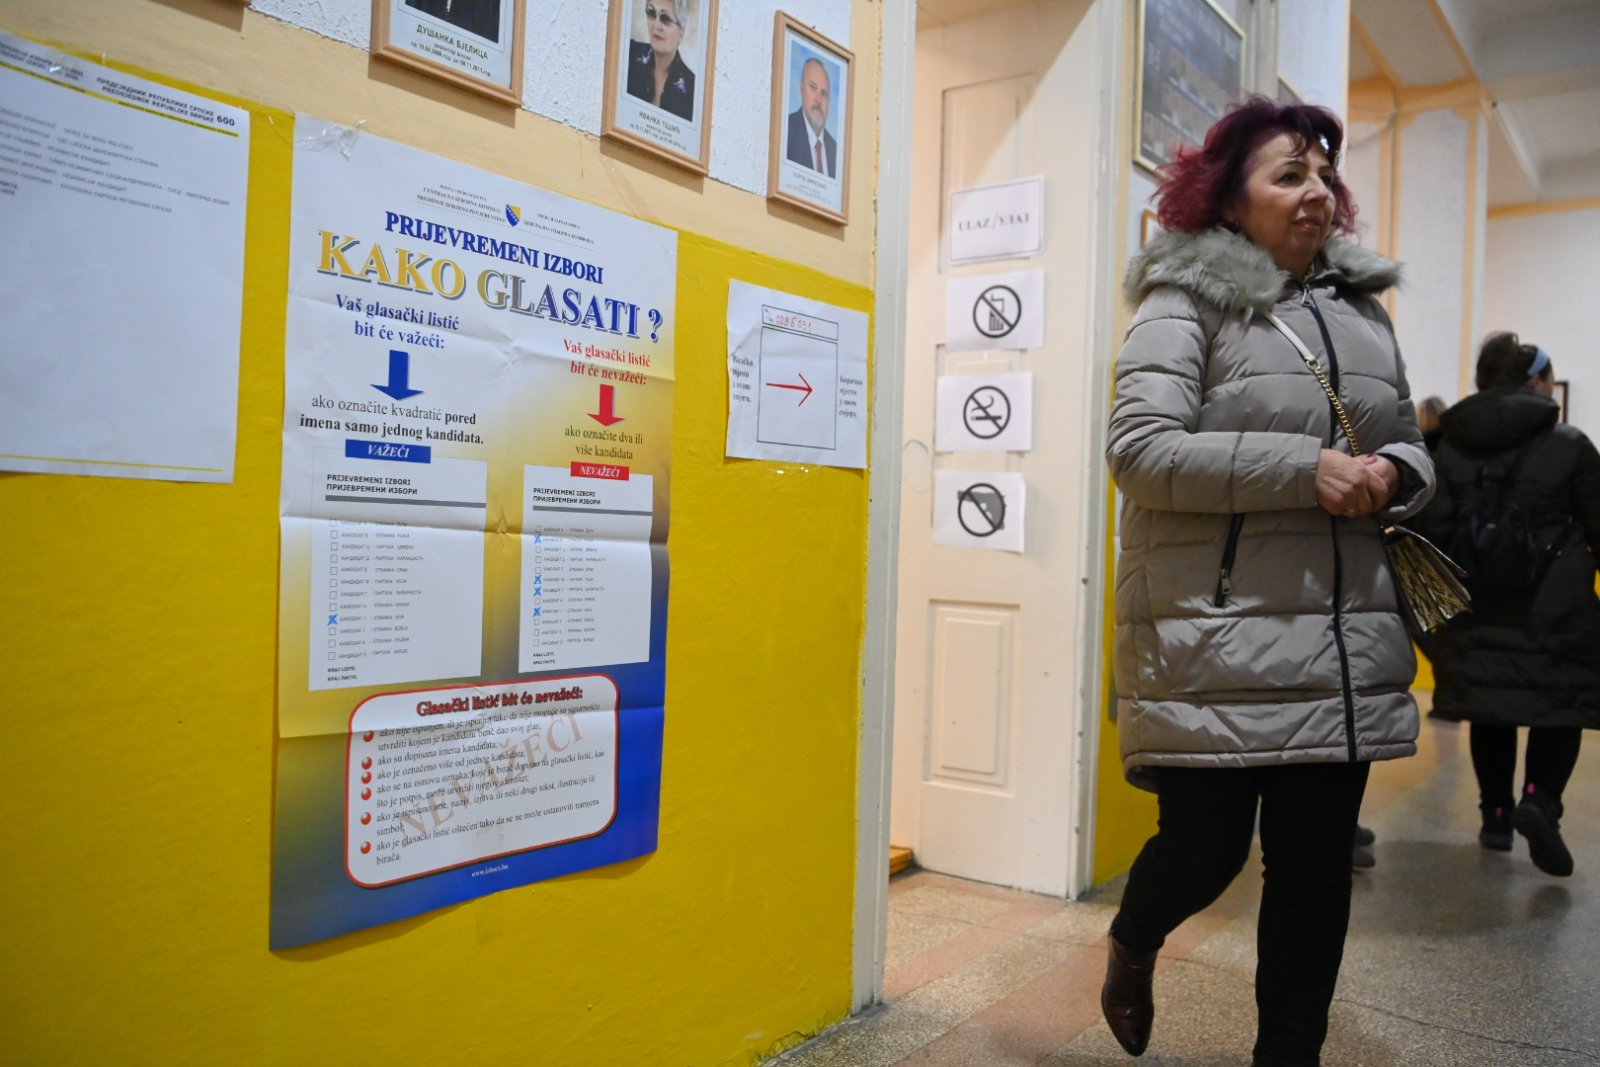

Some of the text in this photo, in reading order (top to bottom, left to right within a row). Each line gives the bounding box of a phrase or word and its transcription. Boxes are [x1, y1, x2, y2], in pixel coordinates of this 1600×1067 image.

[416, 24, 454, 45] ДУШАНКА
[456, 40, 488, 60] БЈЕЛИЦА
[102, 85, 150, 105] PREDSJEDNIK
[152, 100, 188, 116] REPUBLIKE
[189, 111, 214, 123] SRPSKE
[148, 92, 187, 110] РЕПУБЛИКЕ
[189, 105, 214, 117] СРПСКЕ
[217, 115, 235, 126] 600
[639, 110, 660, 125] ИВАНКА
[385, 211, 539, 268] PRIJEVREMENI
[543, 251, 604, 285] IZBORI
[317, 229, 663, 343] KAKO GLASATI ?
[336, 293, 459, 331] Vaš glasački listić
[354, 320, 445, 349] bit će važeći:
[563, 339, 651, 368] Vaš glasački listić
[570, 360, 647, 385] bit će nevažeći:
[312, 395, 476, 425] ako označite kvadratić pored
[299, 413, 484, 445] imena samo jednog kandidata.
[565, 426, 643, 445] ako označite dva ili
[367, 443, 410, 458] VAŽEĆI
[575, 444, 633, 460] više kandidata
[326, 473, 411, 486] PRIJEVREMENI IZBORI
[580, 465, 620, 478] NEVAŽEĆI
[326, 483, 418, 495] ПРИЈЕВРЕМЕНИ ИЗБОРИ
[532, 495, 578, 504] ПРИЈЕВРЕМЕНИ
[533, 487, 576, 496] PRIJEVREMENI
[417, 686, 583, 716] Glasački listić bit će nevažeći:
[379, 727, 394, 737] ako
[465, 715, 492, 728] ispunjen
[493, 713, 507, 722] tako
[509, 712, 518, 720] da
[378, 739, 407, 751] utvrditi
[408, 736, 432, 749] kojem
[433, 735, 441, 746] je
[442, 730, 476, 742] kandidatu
[478, 727, 494, 737] birač
[496, 726, 510, 735] dao
[377, 756, 392, 765] ako
[394, 755, 403, 763] su
[405, 749, 437, 761] dopisana
[438, 747, 461, 756] imena
[377, 769, 392, 779] ako
[393, 768, 400, 779] je
[402, 763, 438, 776] označeno
[439, 760, 454, 769] više
[455, 757, 465, 766] od
[466, 755, 490, 768] jednog
[377, 782, 391, 793] ako
[393, 783, 401, 791] se
[403, 781, 412, 789] na
[414, 778, 441, 787] osnovu
[488, 765, 495, 776] je
[550, 754, 576, 767] glasački
[398, 713, 584, 846] NEVAŽEĆI
[376, 798, 388, 808] što
[390, 797, 397, 808] je
[399, 793, 424, 806] potpis,
[447, 784, 474, 795] utvrditi
[475, 781, 498, 793] njegov
[377, 812, 391, 822] ako
[392, 811, 400, 821] je
[473, 794, 494, 805] izjava
[504, 789, 519, 798] neki
[520, 785, 538, 796] drugi
[539, 781, 556, 793] tekst,
[557, 776, 588, 788] ilustracija
[376, 841, 390, 851] ako
[392, 840, 400, 850] je
[401, 832, 431, 848] glasački
[433, 828, 451, 838] listić
[452, 823, 477, 834] oštećen
[479, 819, 495, 828] tako
[496, 817, 504, 825] da
[523, 809, 542, 820] može
[543, 803, 574, 815] ustanoviti
[376, 854, 401, 865] birača.
